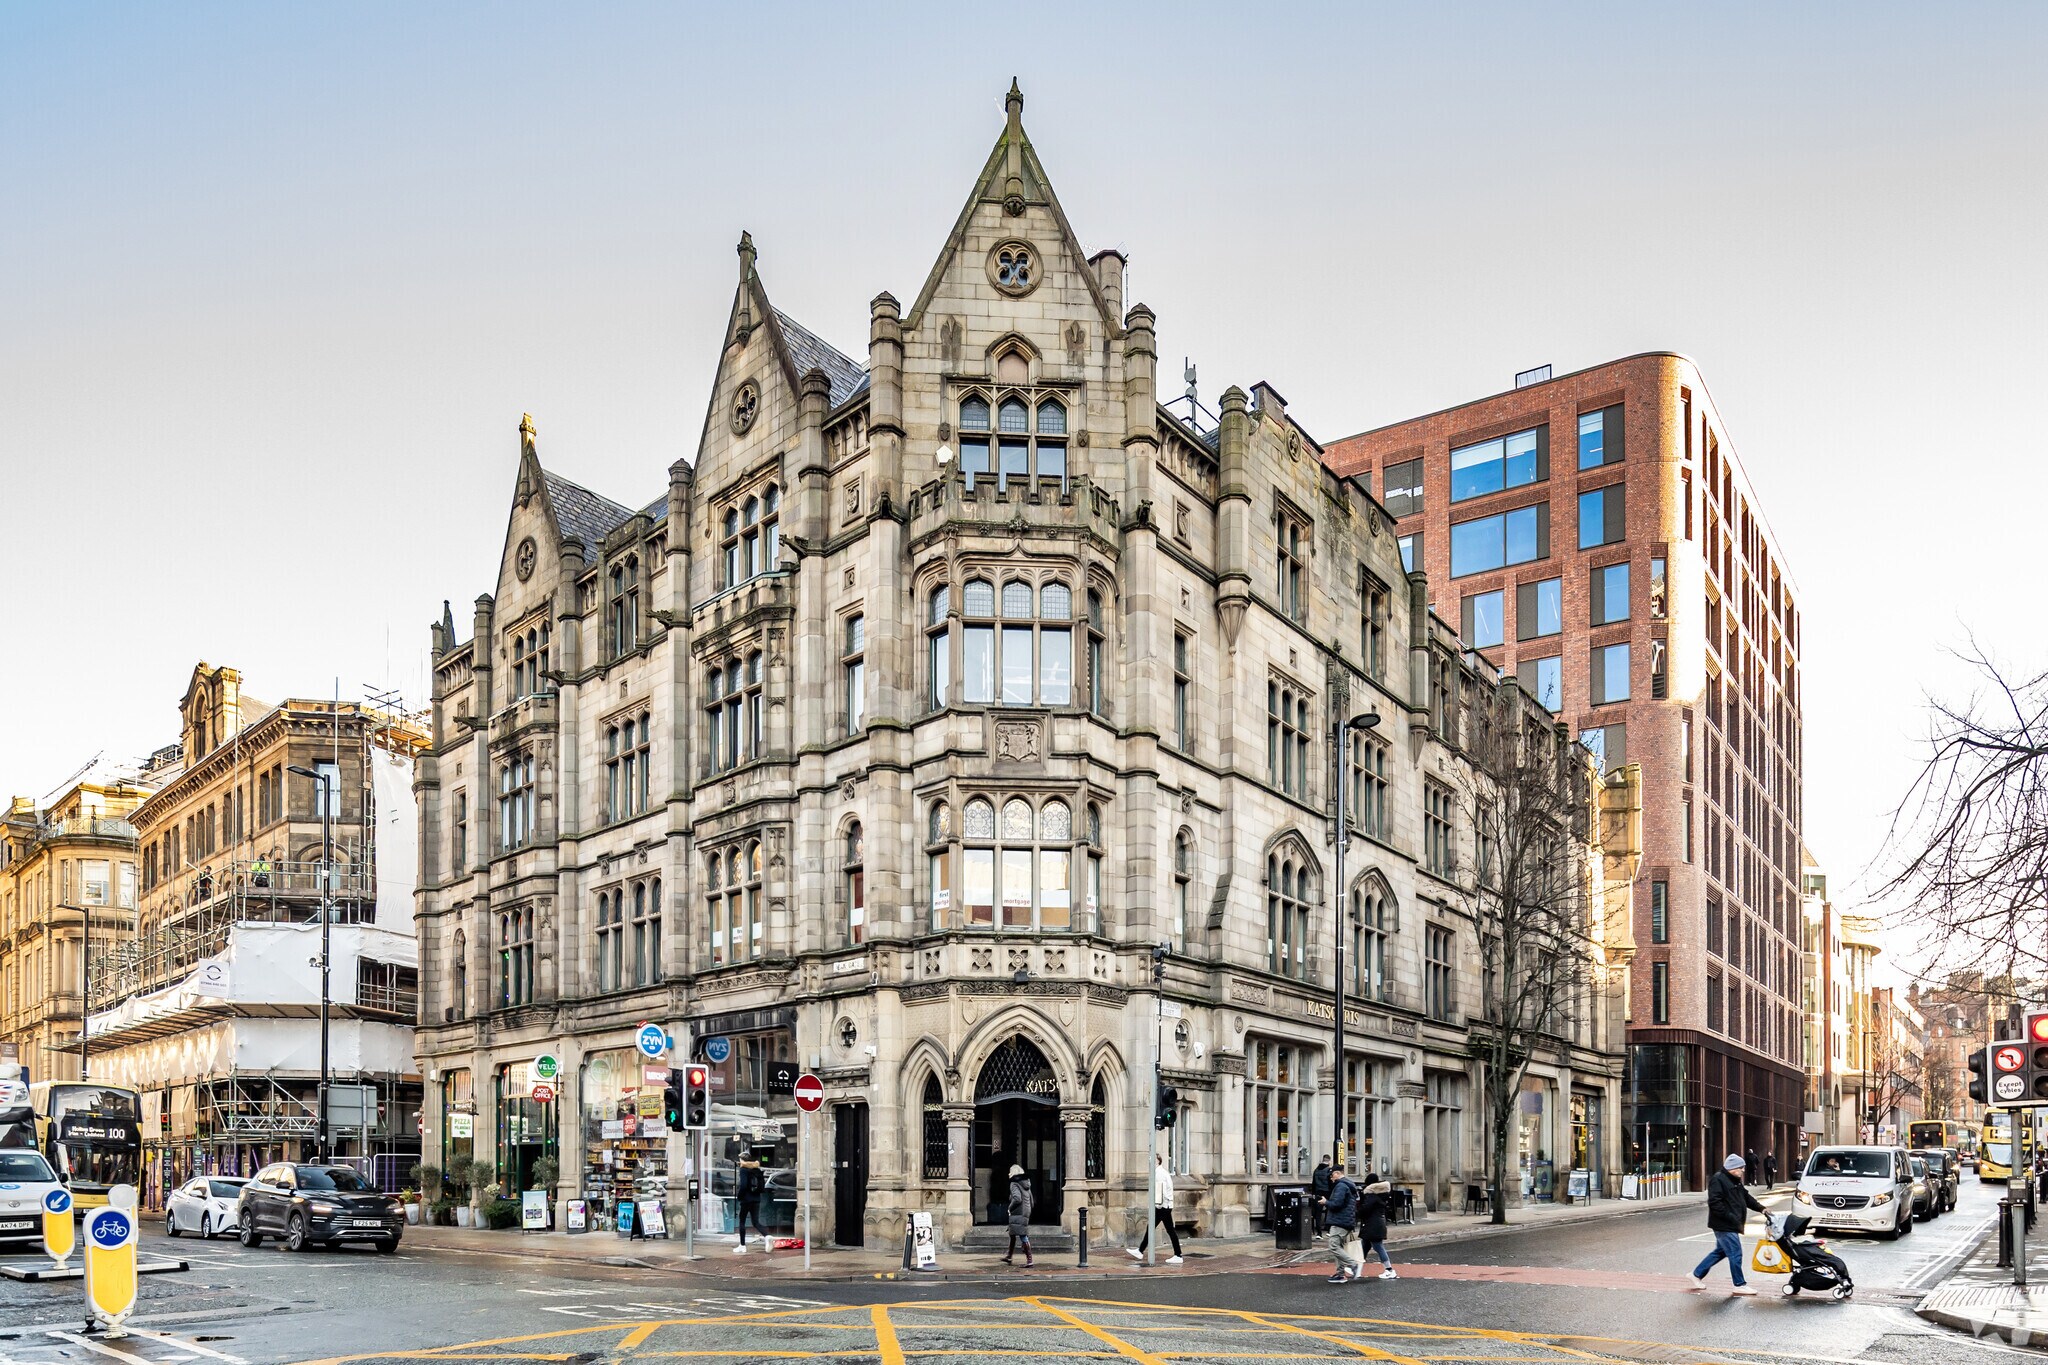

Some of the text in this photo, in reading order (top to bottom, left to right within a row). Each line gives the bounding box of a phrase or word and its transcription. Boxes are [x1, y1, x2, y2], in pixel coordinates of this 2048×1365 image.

[1307, 1000, 1359, 1026] KATSORIS
[642, 1035, 662, 1046] ZYN
[108, 1128, 125, 1139] 100
